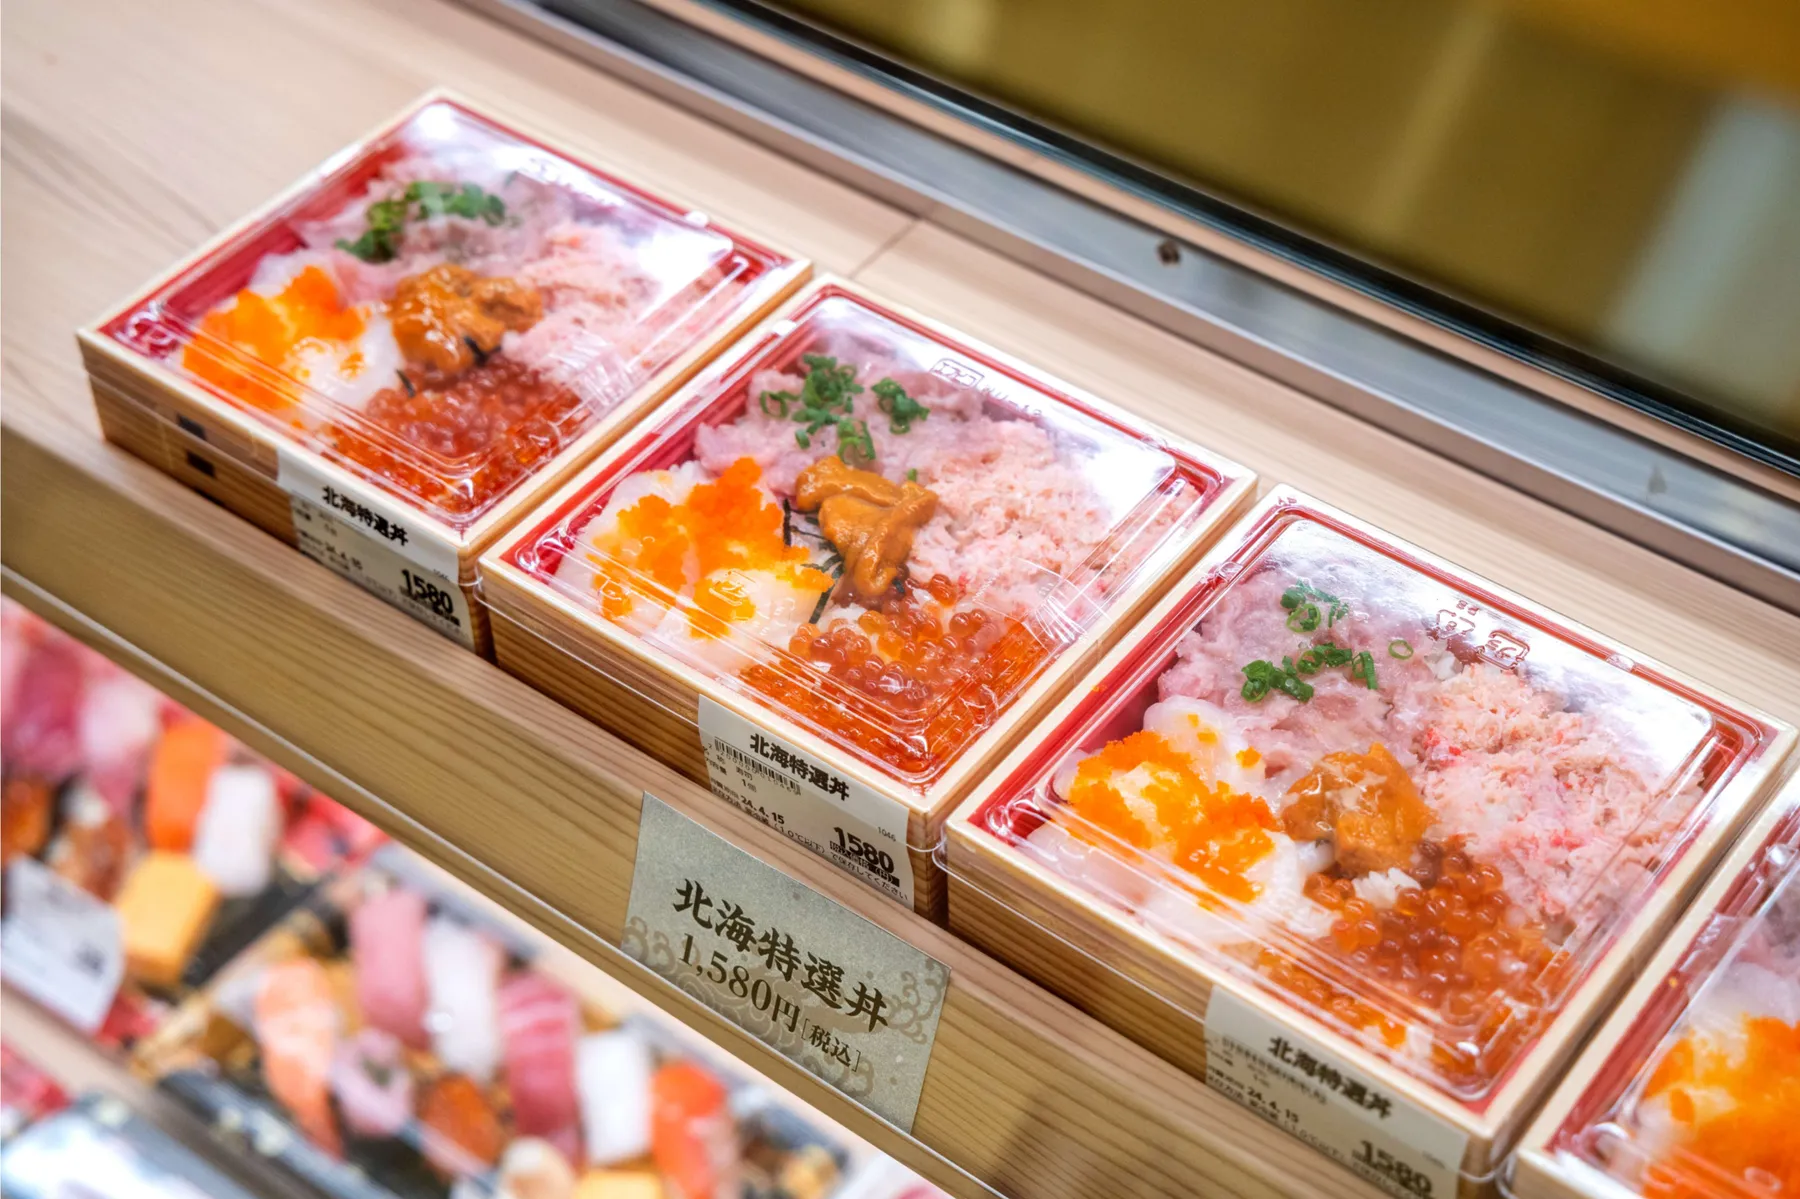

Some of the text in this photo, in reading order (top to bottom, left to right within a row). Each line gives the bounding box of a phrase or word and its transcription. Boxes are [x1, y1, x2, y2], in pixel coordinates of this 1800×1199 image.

[323, 485, 408, 546] 北海特選丼
[402, 569, 453, 615] 1580
[750, 733, 849, 801] 北海特選丼
[833, 826, 894, 874] 1580
[878, 826, 896, 841] 1046
[672, 877, 889, 1032] 北海特選丼
[1268, 1037, 1391, 1119] 北海特選丼
[1360, 1140, 1432, 1196] 1580
